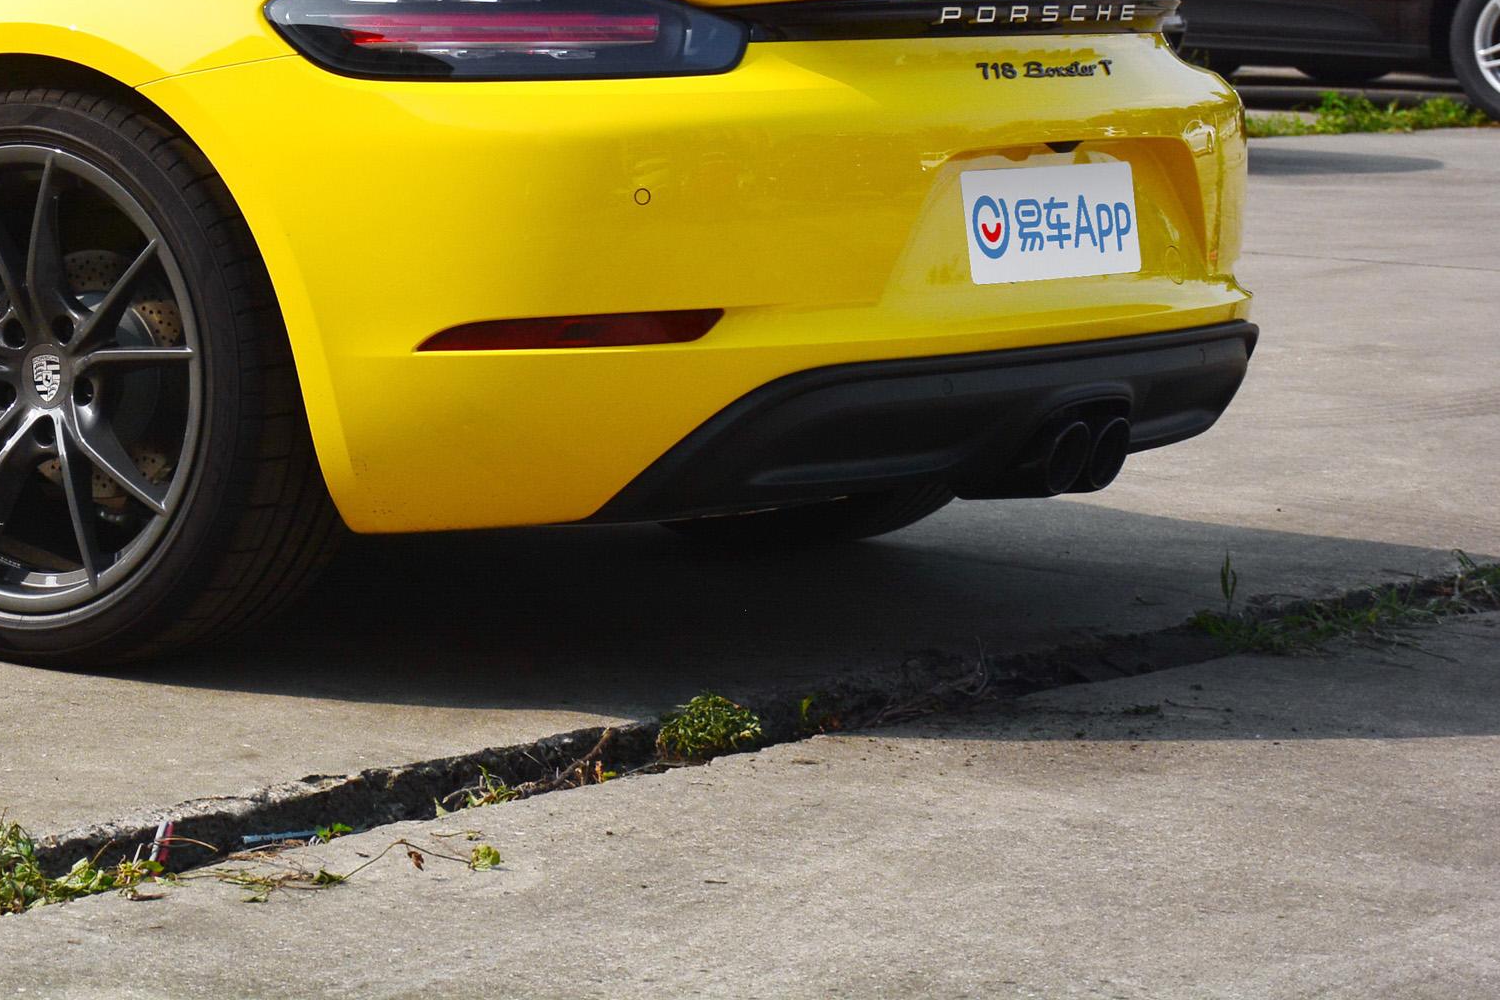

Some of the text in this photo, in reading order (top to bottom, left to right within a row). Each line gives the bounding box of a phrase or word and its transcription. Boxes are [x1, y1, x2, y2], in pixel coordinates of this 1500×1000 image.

[940, 4, 1136, 24] PORSCHE
[975, 59, 1112, 80] 718 Boxster T
[1014, 194, 1132, 254] 易车App
